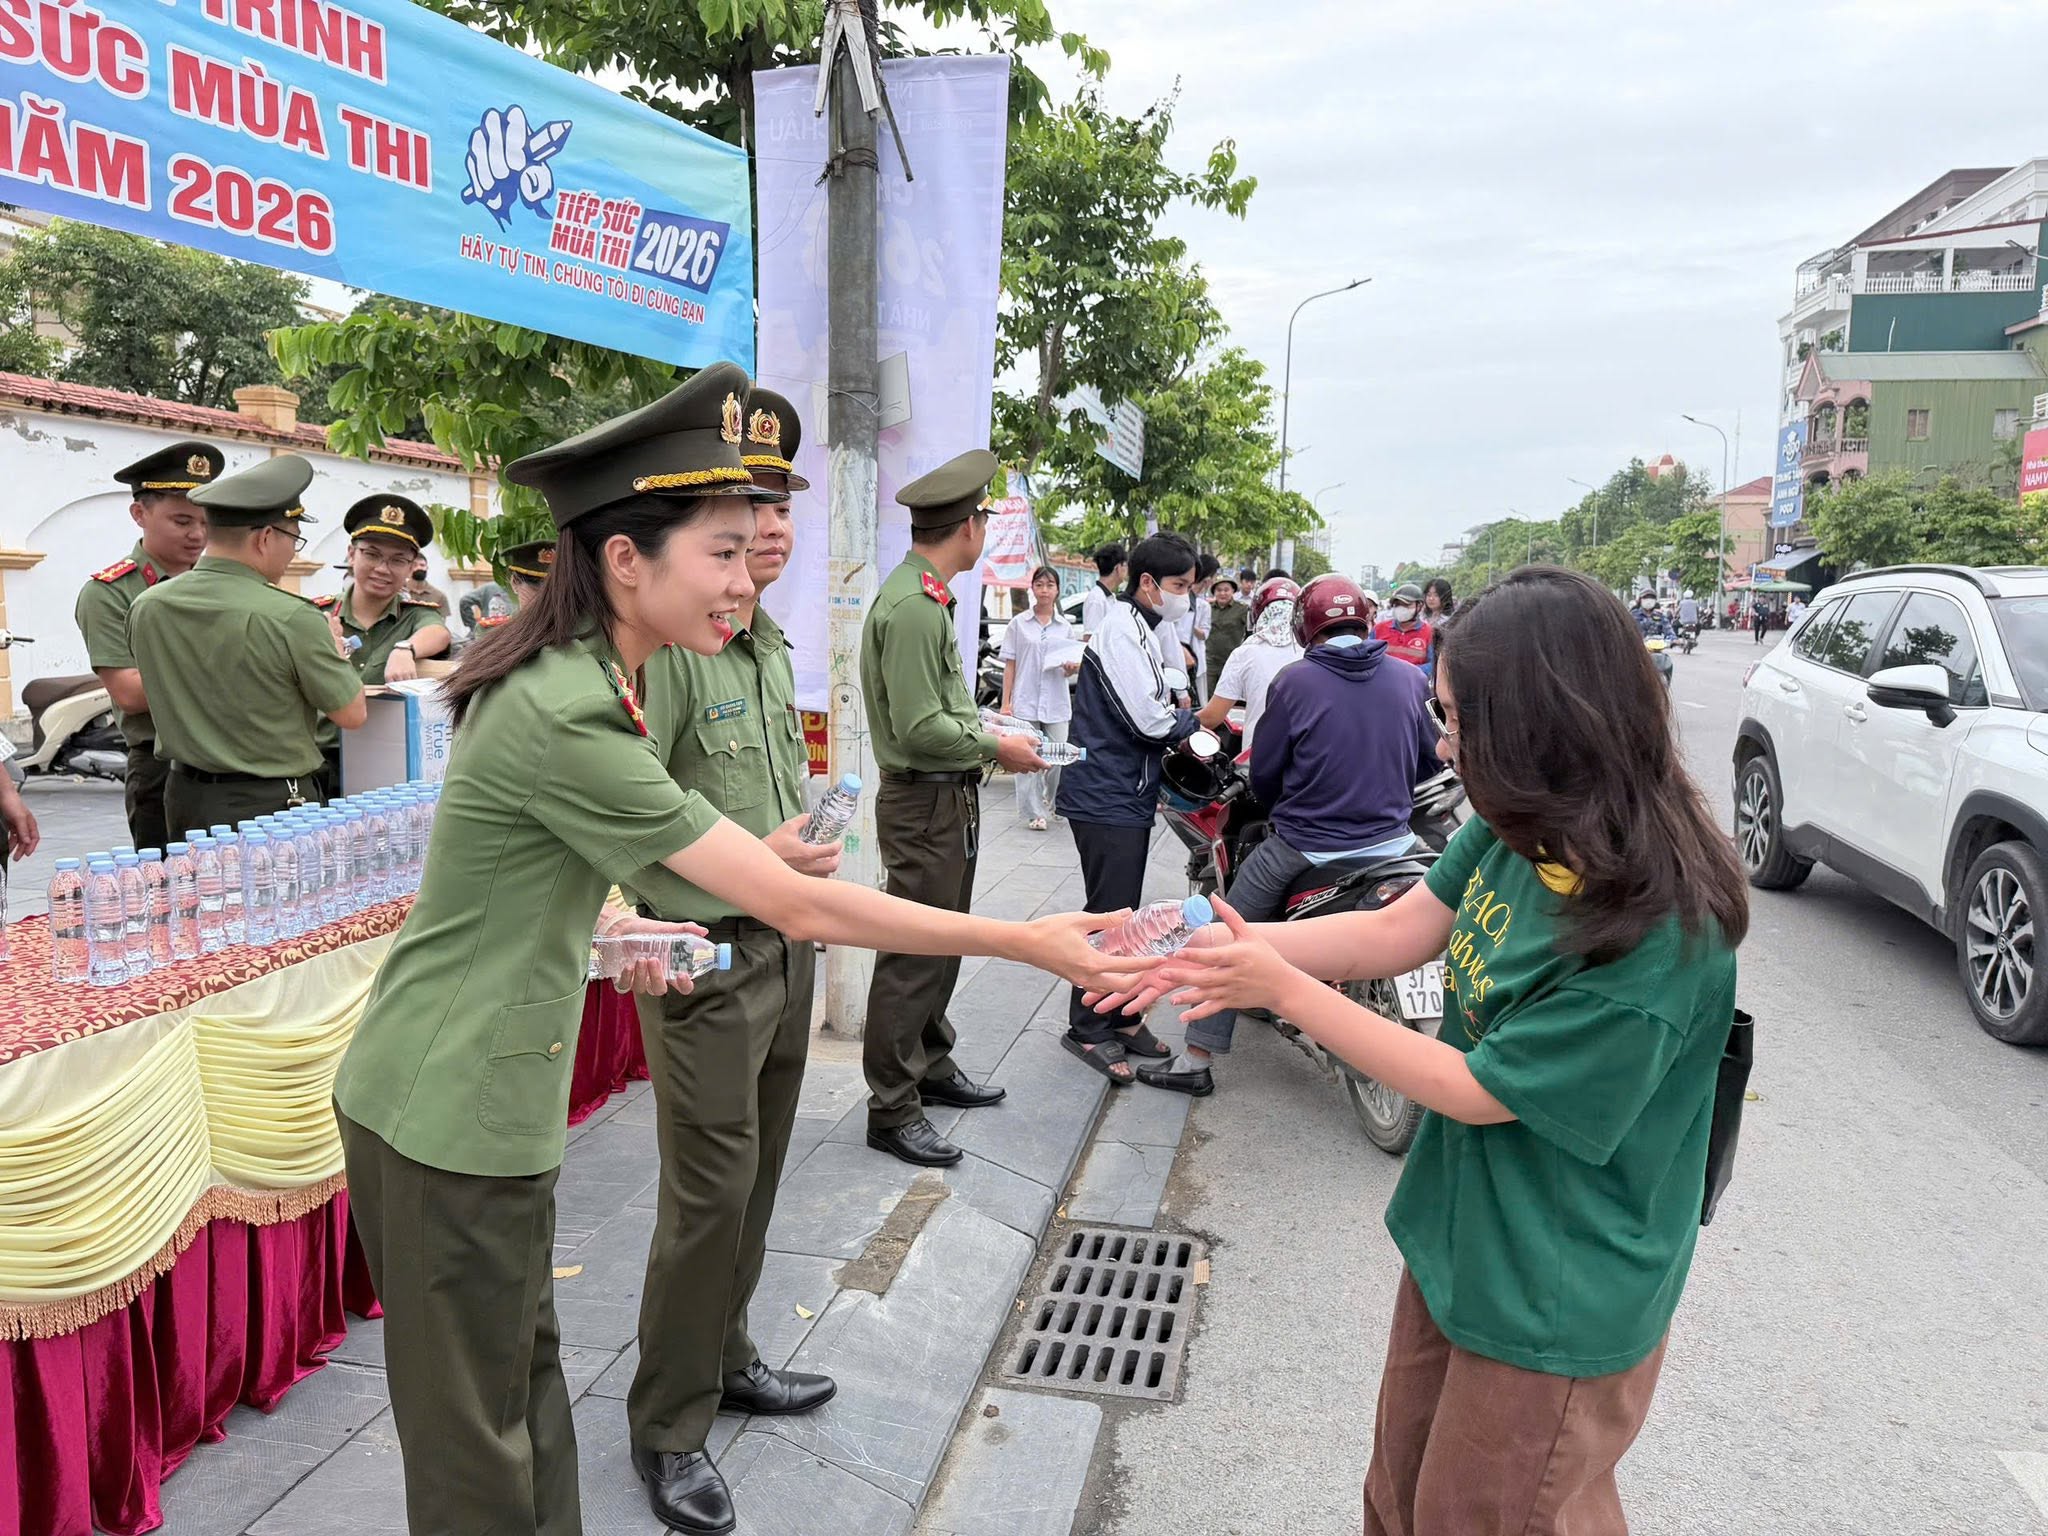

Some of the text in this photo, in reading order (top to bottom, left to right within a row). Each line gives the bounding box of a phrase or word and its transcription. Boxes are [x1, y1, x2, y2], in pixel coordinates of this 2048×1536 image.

[172, 49, 325, 155] MÙA
[341, 108, 429, 188] THI
[0, 98, 331, 251] ĂM 2026
[556, 190, 641, 236] TIẾP SỨC
[551, 222, 632, 269] MÙA THI
[634, 222, 720, 285] 2026
[461, 234, 705, 323] HÃY TỰ TIN, CHÚNG TÔI ĐI CÙNG BẠN
[425, 723, 433, 761] WATER
[432, 722, 444, 760] true
